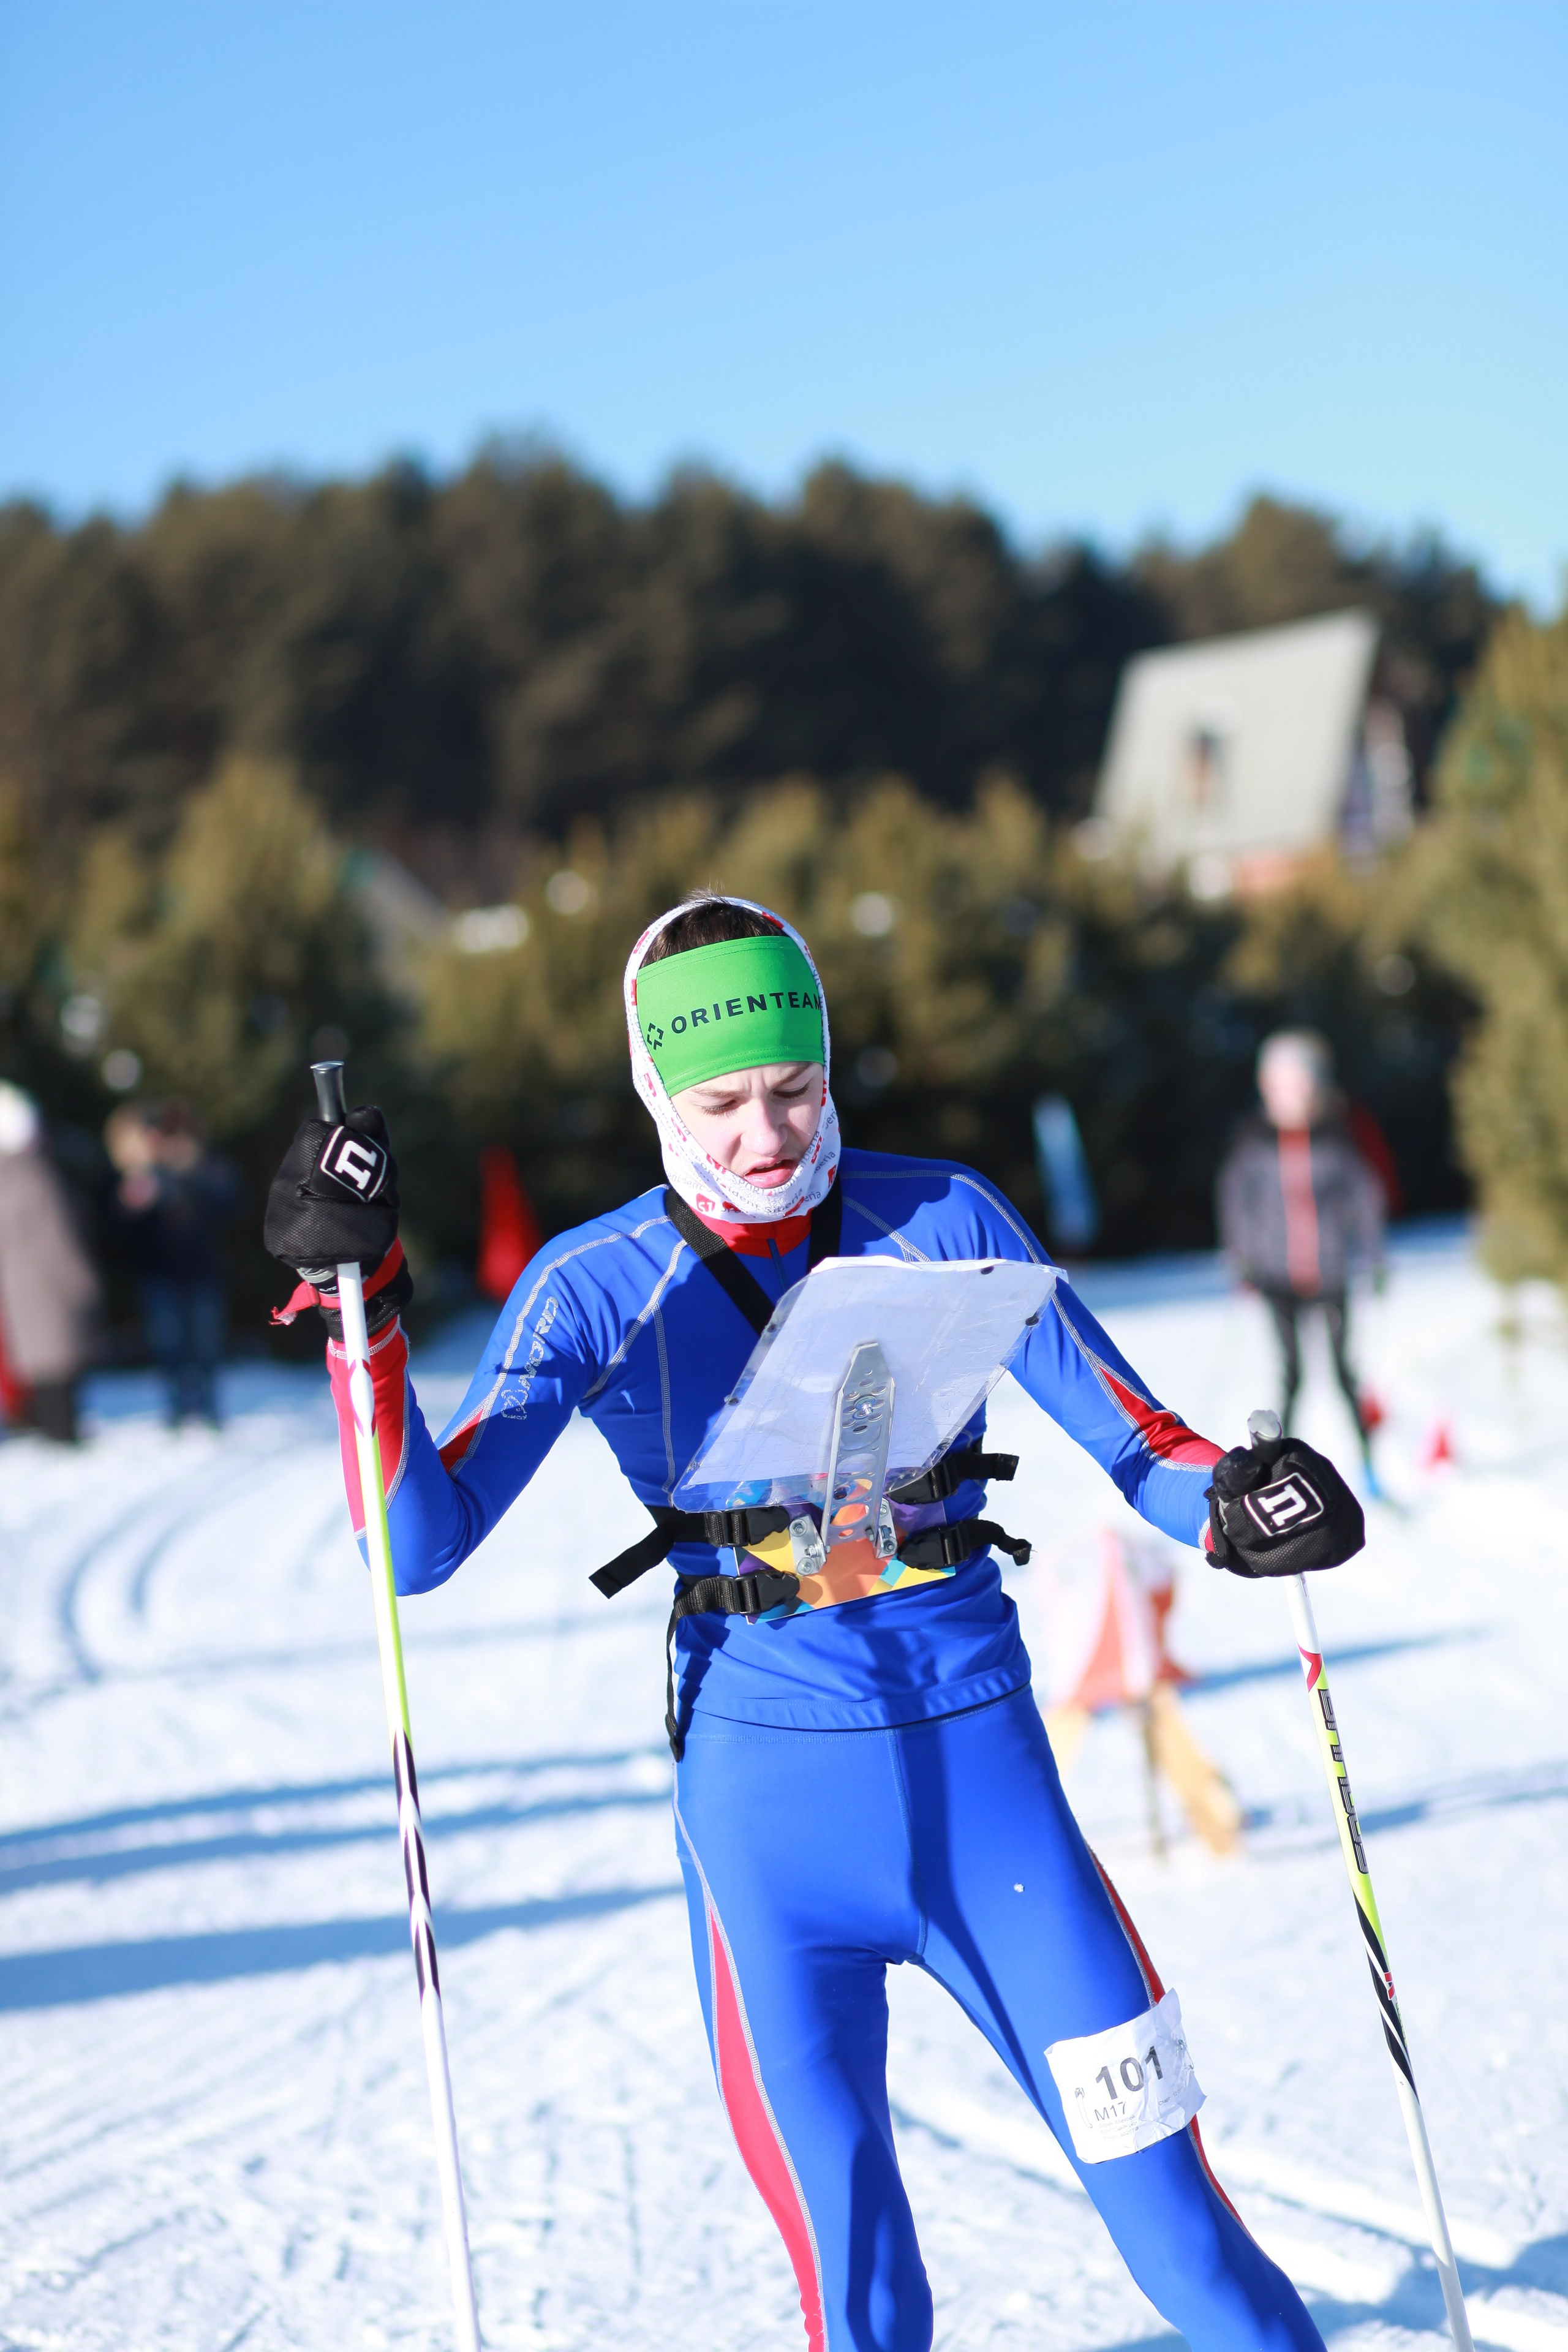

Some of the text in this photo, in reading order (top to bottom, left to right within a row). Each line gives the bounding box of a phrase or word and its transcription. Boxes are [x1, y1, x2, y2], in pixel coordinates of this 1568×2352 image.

[671, 992, 820, 1034] ORIENTEAM
[1095, 2045, 1164, 2100] 101
[1094, 2101, 1127, 2122] M17
